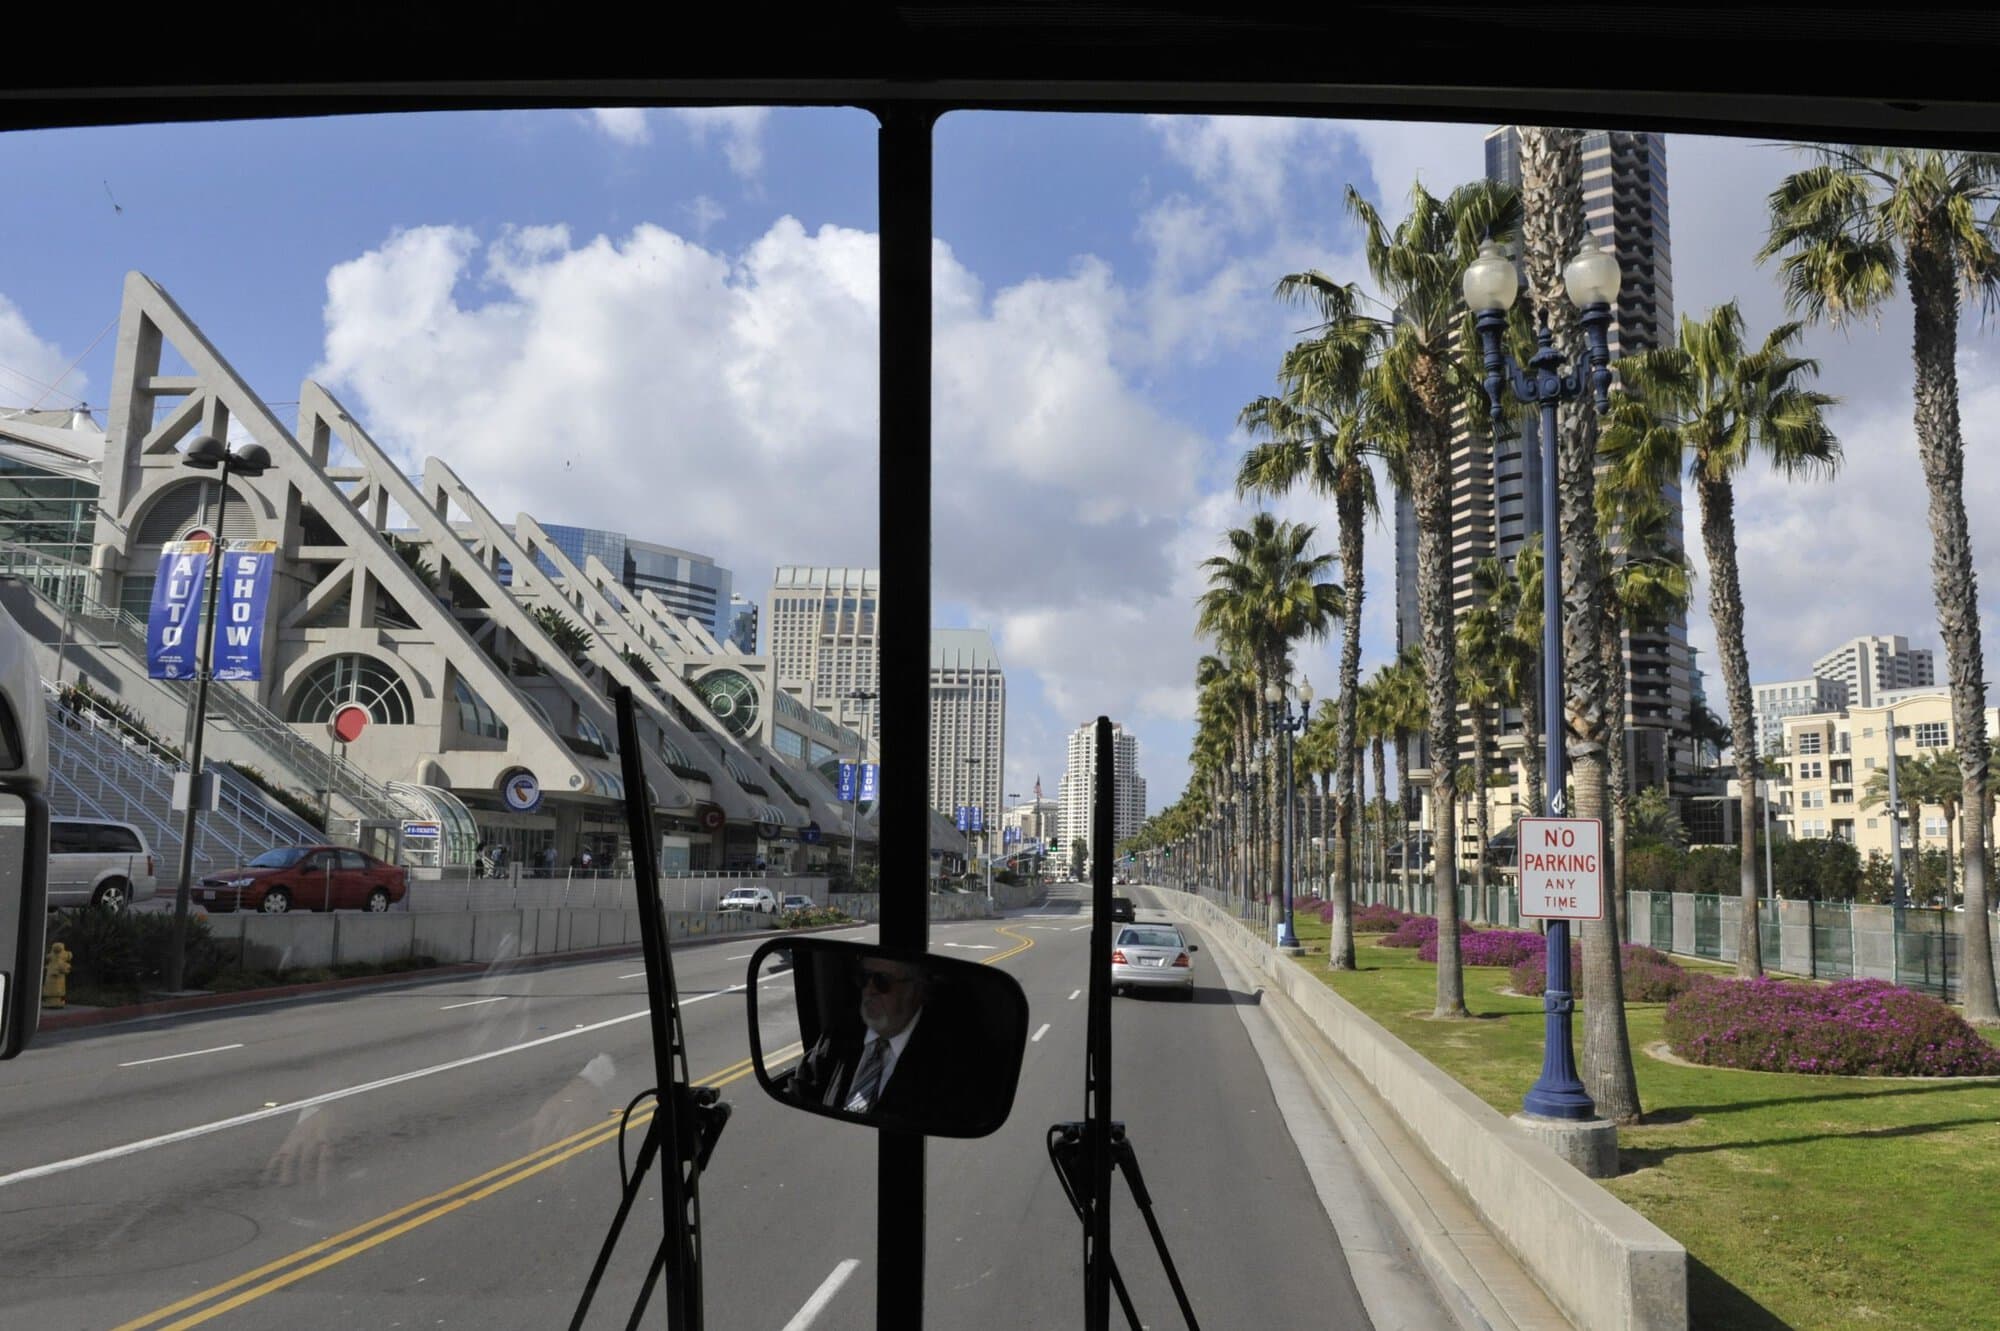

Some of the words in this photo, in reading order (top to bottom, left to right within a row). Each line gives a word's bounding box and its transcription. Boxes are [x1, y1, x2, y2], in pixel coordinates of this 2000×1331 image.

[162, 556, 193, 647] AUTO
[226, 556, 257, 647] SHOW
[1545, 829, 1575, 848] NO
[1525, 854, 1596, 872] PARKING
[1545, 878, 1576, 889] ANY
[1544, 896, 1577, 909] TIME
